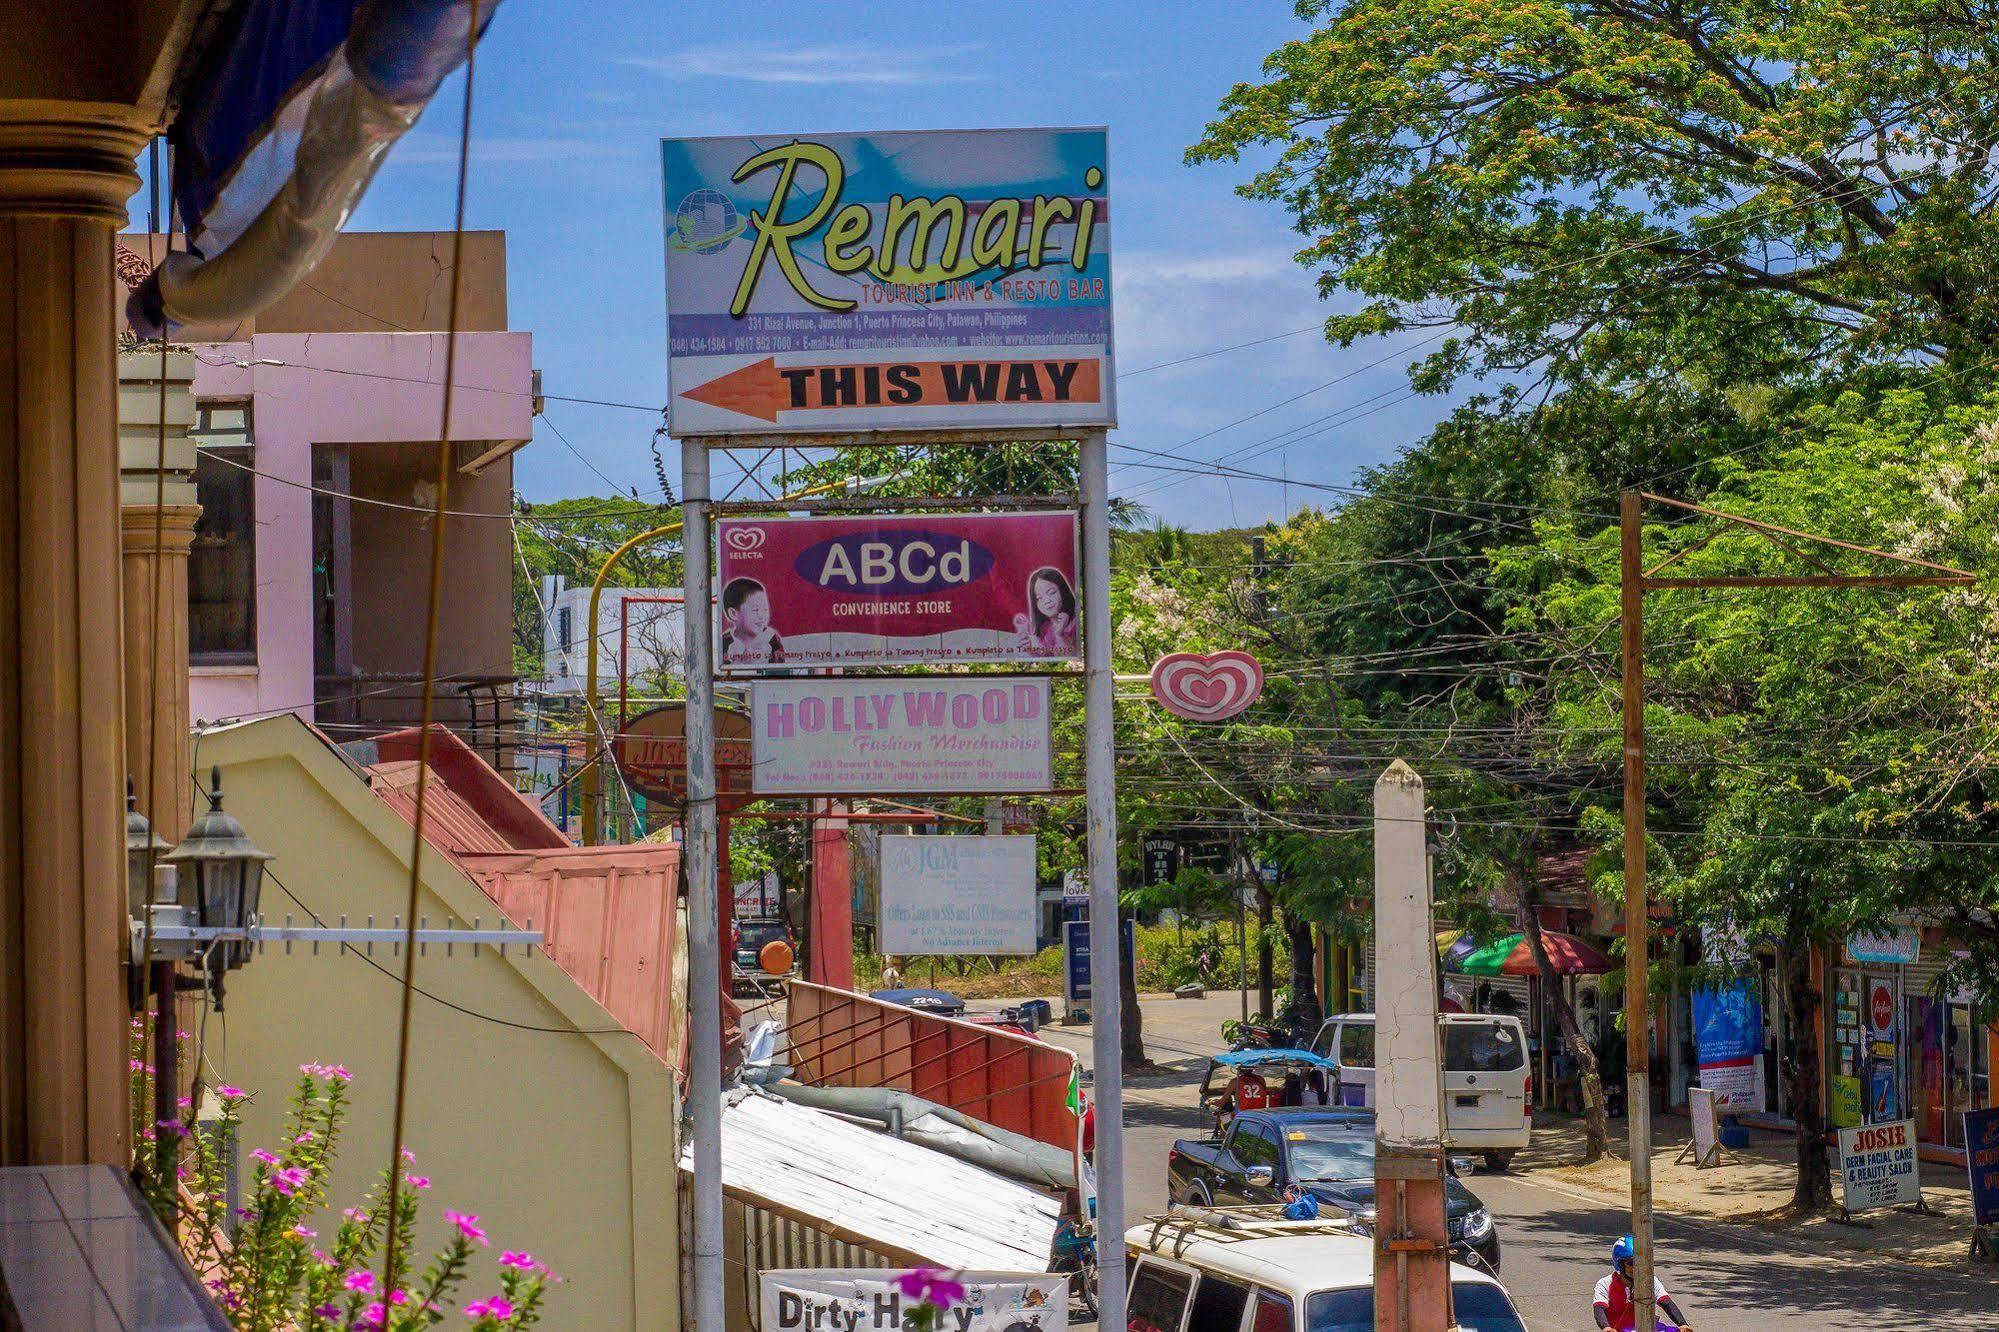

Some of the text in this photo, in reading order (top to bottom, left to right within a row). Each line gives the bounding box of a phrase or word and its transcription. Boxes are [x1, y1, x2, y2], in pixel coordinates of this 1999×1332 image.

[731, 139, 1104, 319] Remari
[862, 277, 1105, 304] TOURIST INN & RESTO BAR
[818, 314, 852, 331] Junction
[863, 314, 890, 330] Puerto
[891, 313, 926, 329] Princesa
[984, 311, 1028, 329] Philippines
[781, 361, 1079, 408] THIS WAY
[729, 551, 764, 560] SELECTA
[819, 539, 971, 586] ABCd
[832, 600, 952, 616] CONVENIENCE STORE
[1243, 1084, 1261, 1099] 32
[1853, 1125, 1906, 1152] JOSIE
[1846, 1147, 1913, 1169] DERM FACIAL CARE
[1848, 1160, 1913, 1182] & BEAUTY SALON
[779, 1290, 860, 1332] Dirty
